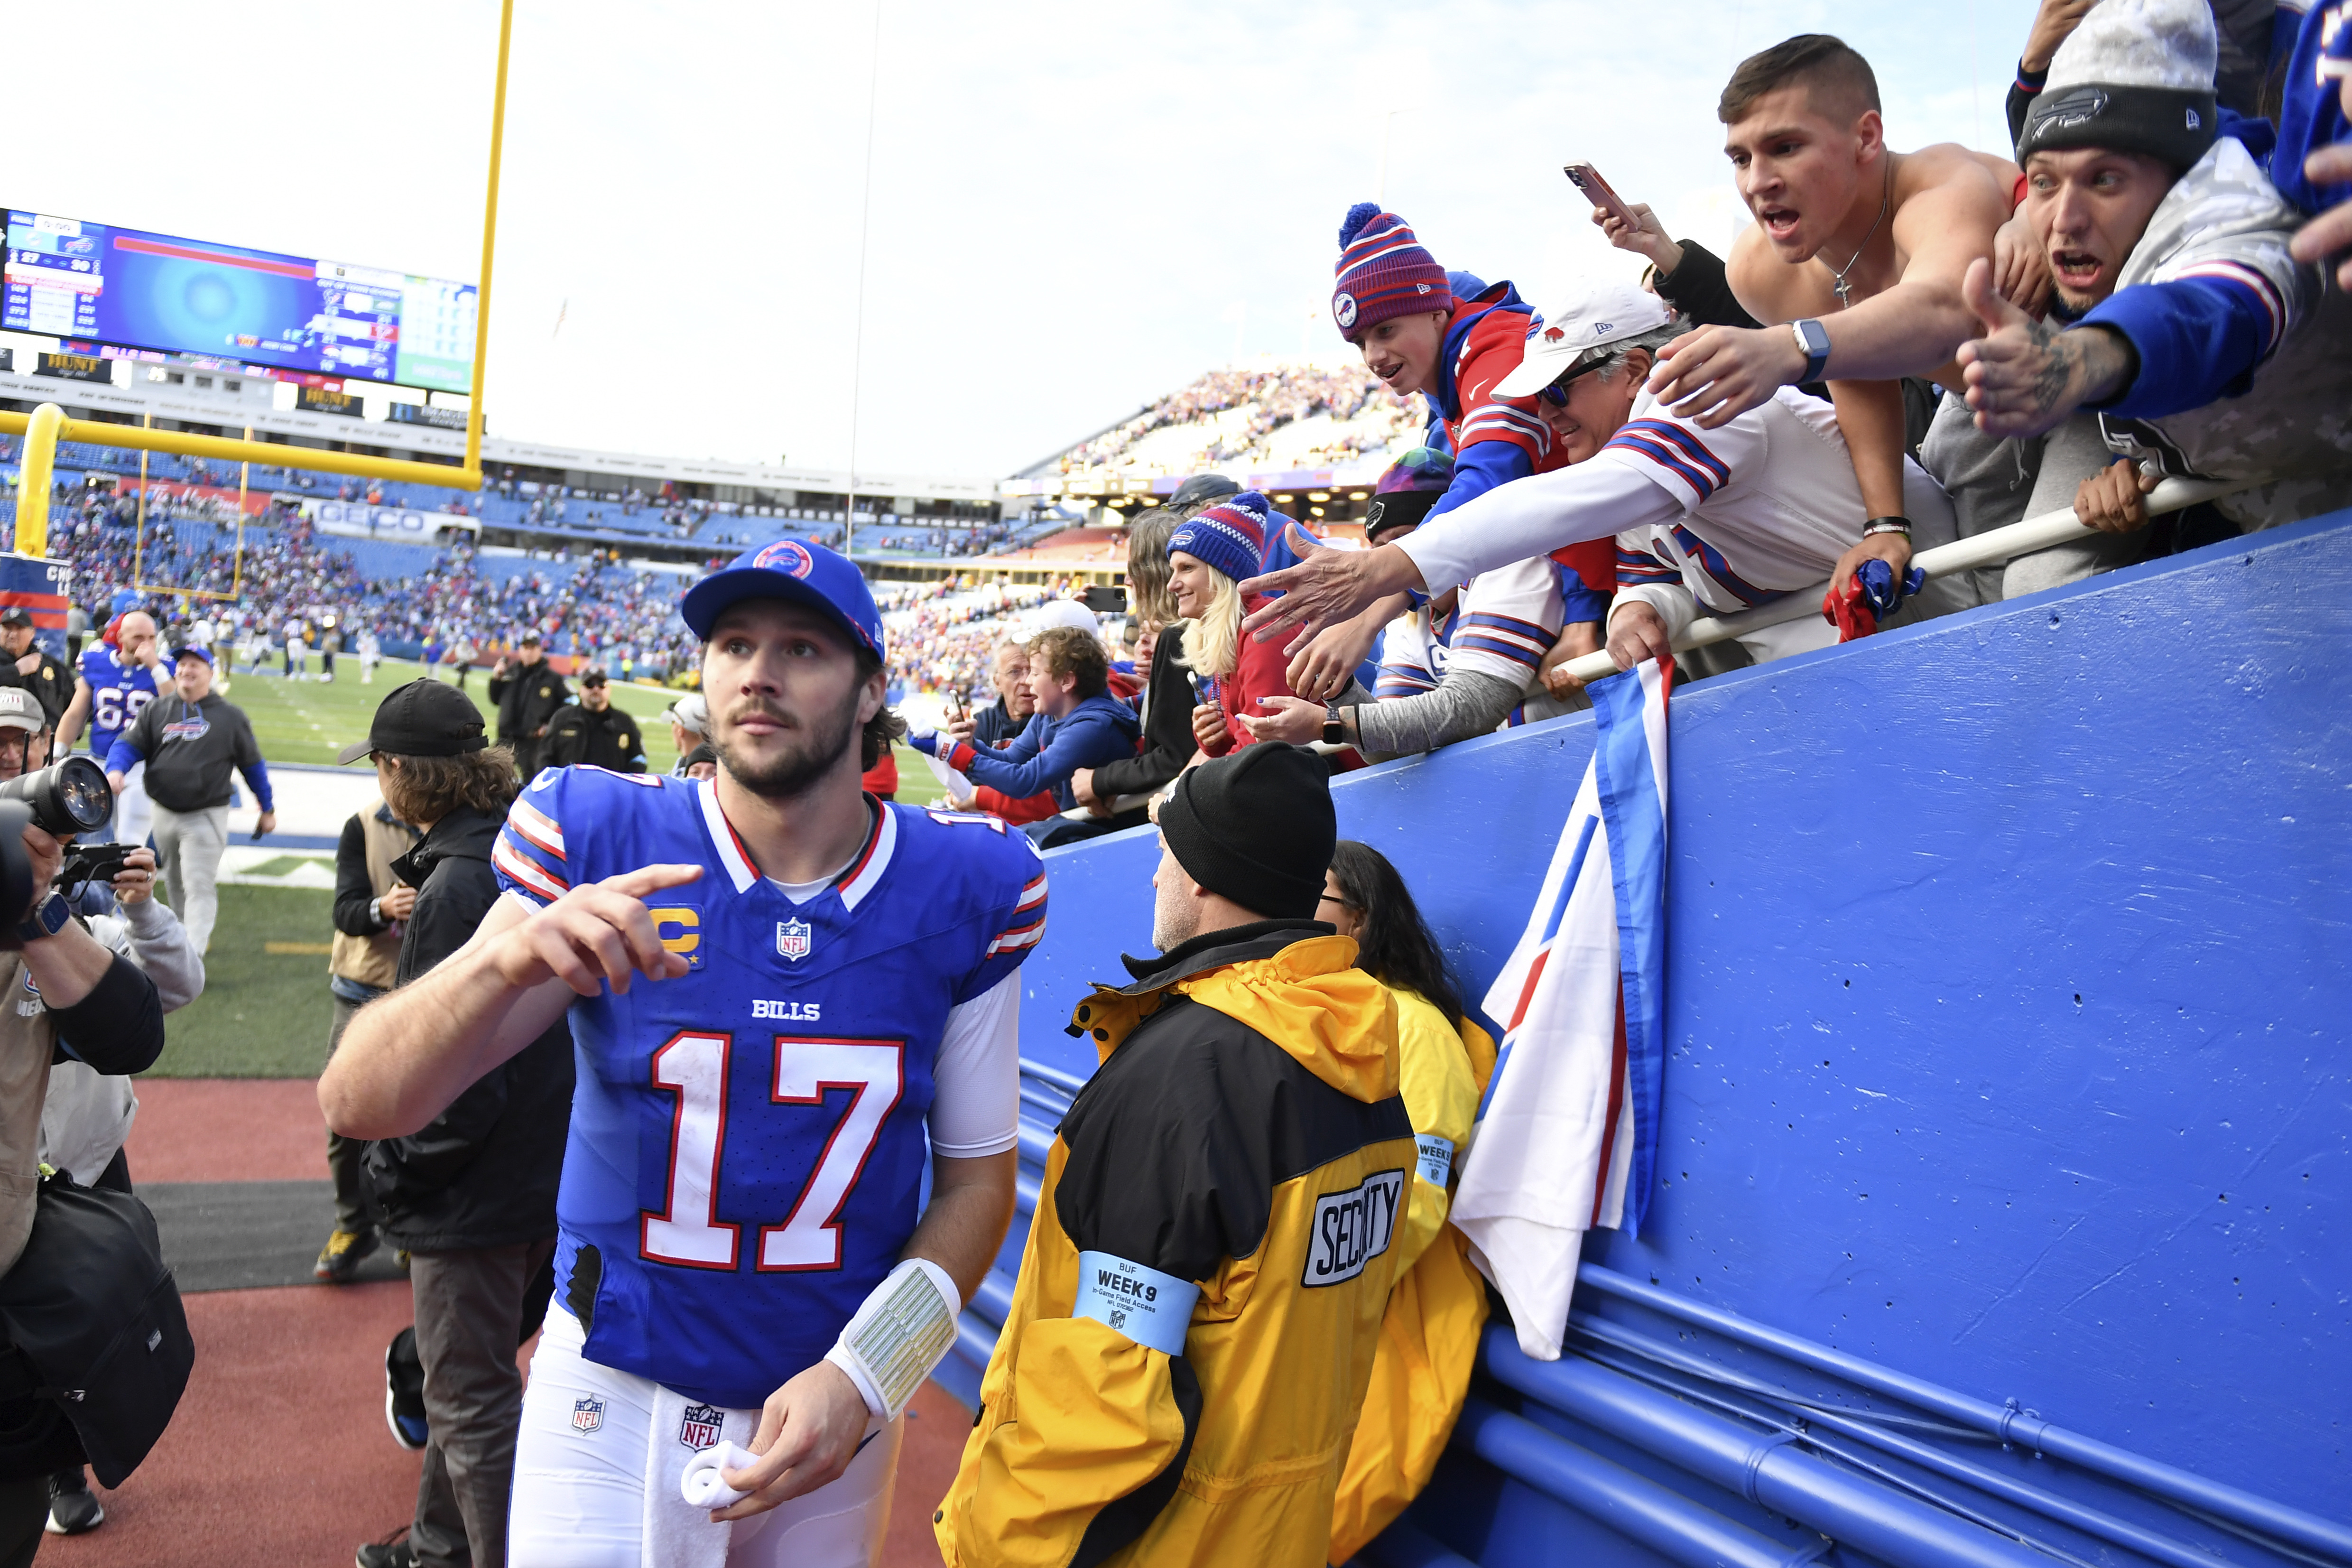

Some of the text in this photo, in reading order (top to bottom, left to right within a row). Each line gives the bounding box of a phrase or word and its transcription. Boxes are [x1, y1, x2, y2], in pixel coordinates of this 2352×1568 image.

[21, 251, 40, 264] 27
[71, 259, 91, 270] 30
[320, 501, 424, 531] GEICO
[647, 908, 700, 952] C
[781, 937, 806, 953] NFL
[751, 999, 821, 1021] BILLS
[639, 1030, 905, 1273] 17
[1419, 1144, 1446, 1160] WEEK
[1119, 1262, 1137, 1274] BUF
[1098, 1269, 1157, 1302] WEEK 9
[1092, 1286, 1156, 1313] In-Game Field Access
[1110, 1316, 1123, 1327] NFL
[575, 1412, 597, 1427] NFL
[682, 1422, 715, 1447] NFL
